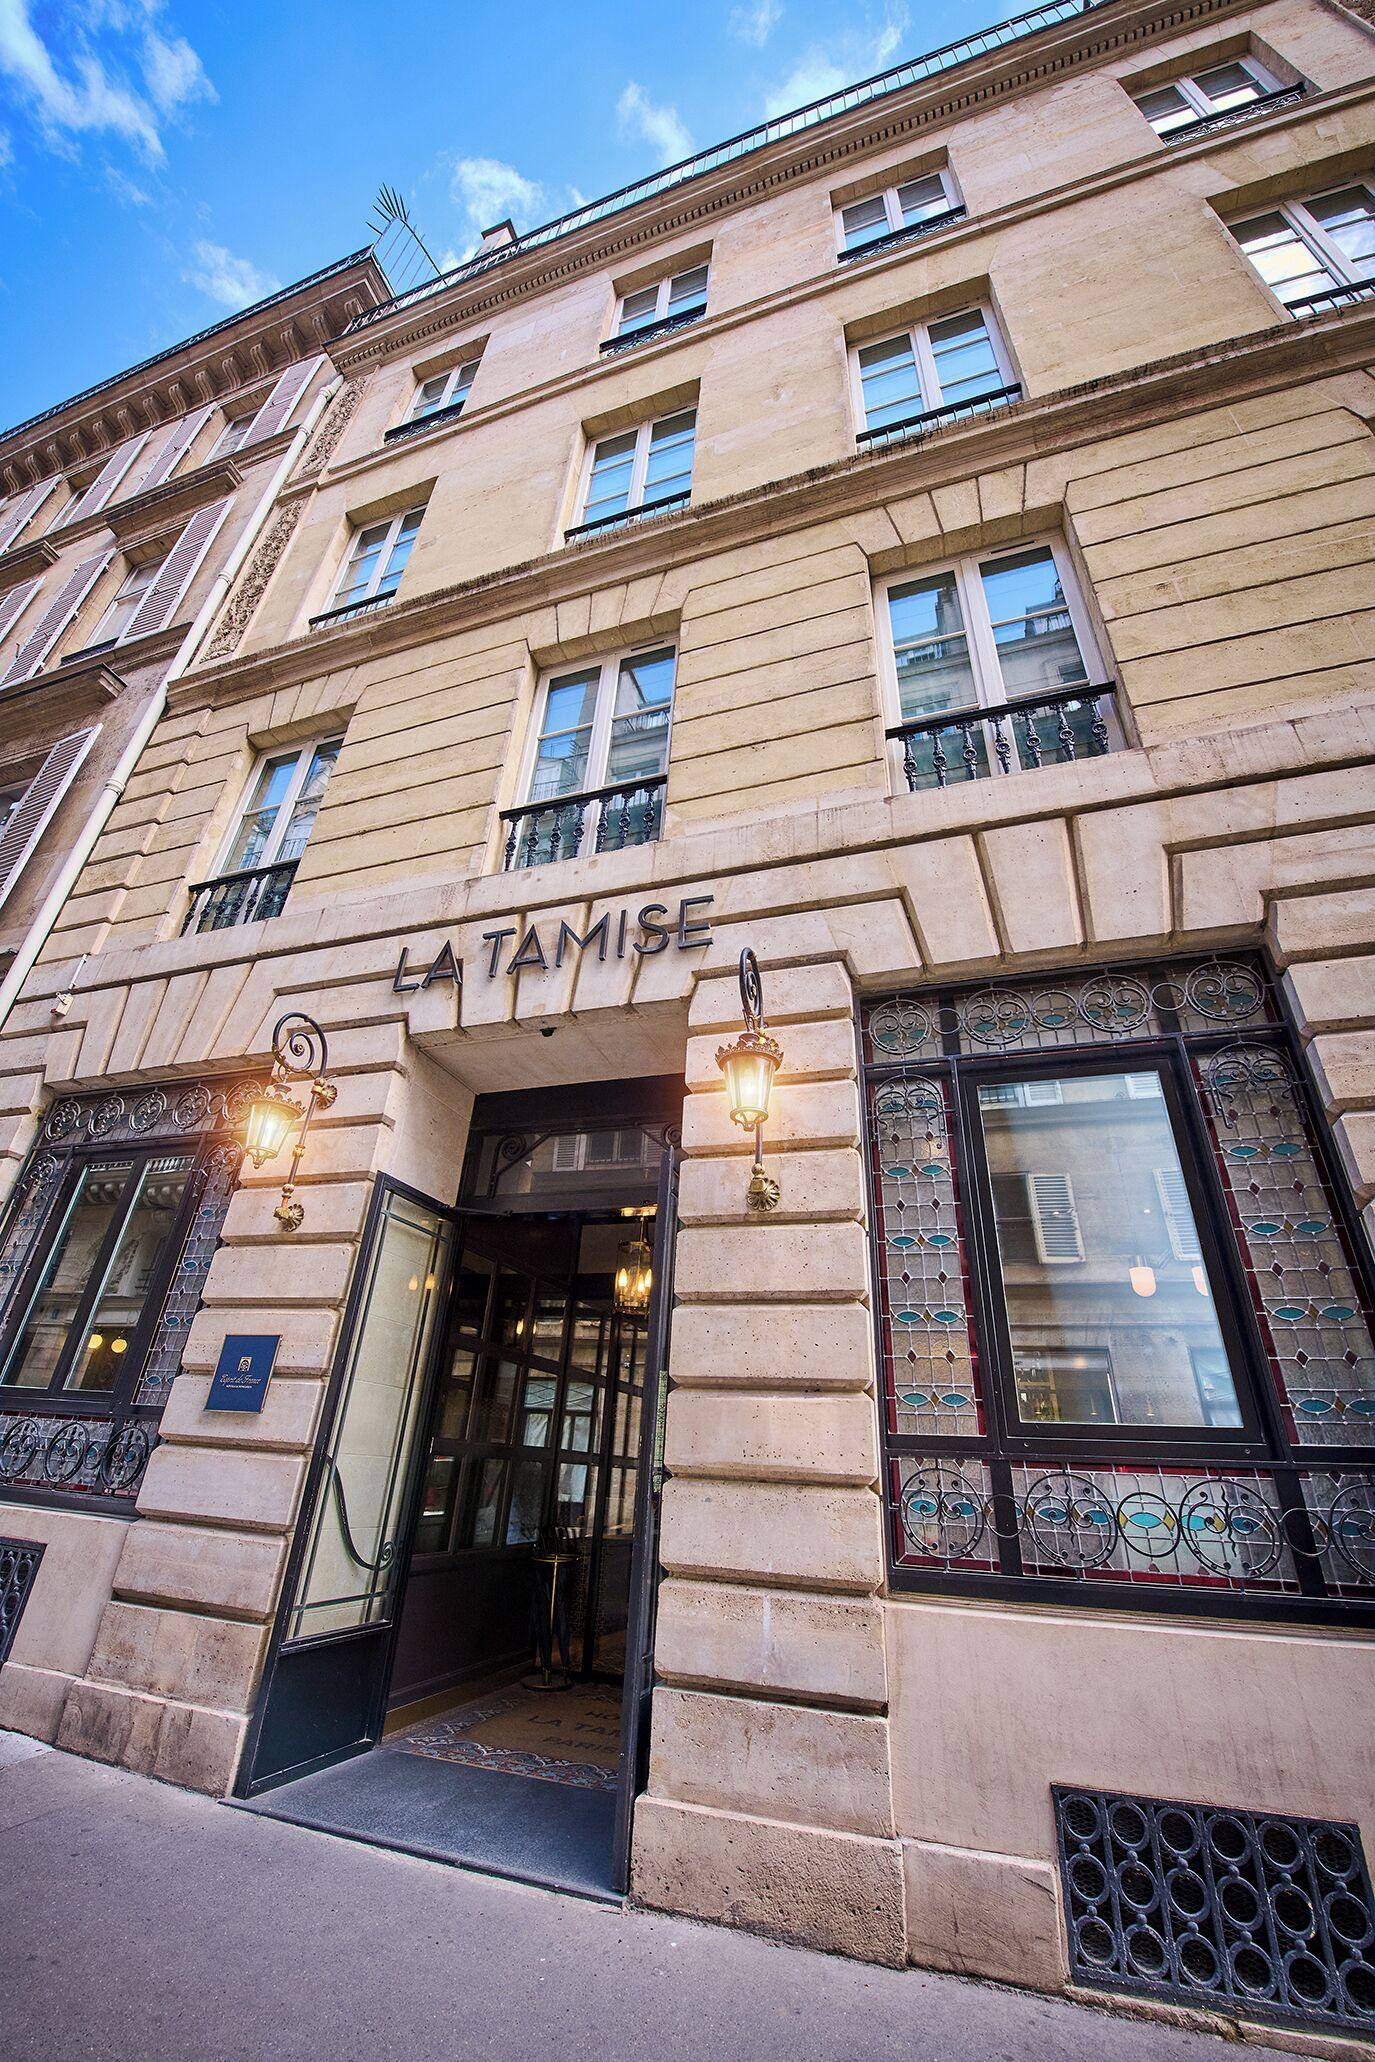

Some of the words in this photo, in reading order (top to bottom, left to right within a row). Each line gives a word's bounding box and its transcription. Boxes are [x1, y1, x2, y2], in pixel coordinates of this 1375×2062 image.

[392, 939, 463, 993] LA
[482, 894, 715, 978] TAMISE
[527, 1715, 562, 1728] LA
[542, 1736, 620, 1753] PARIS
